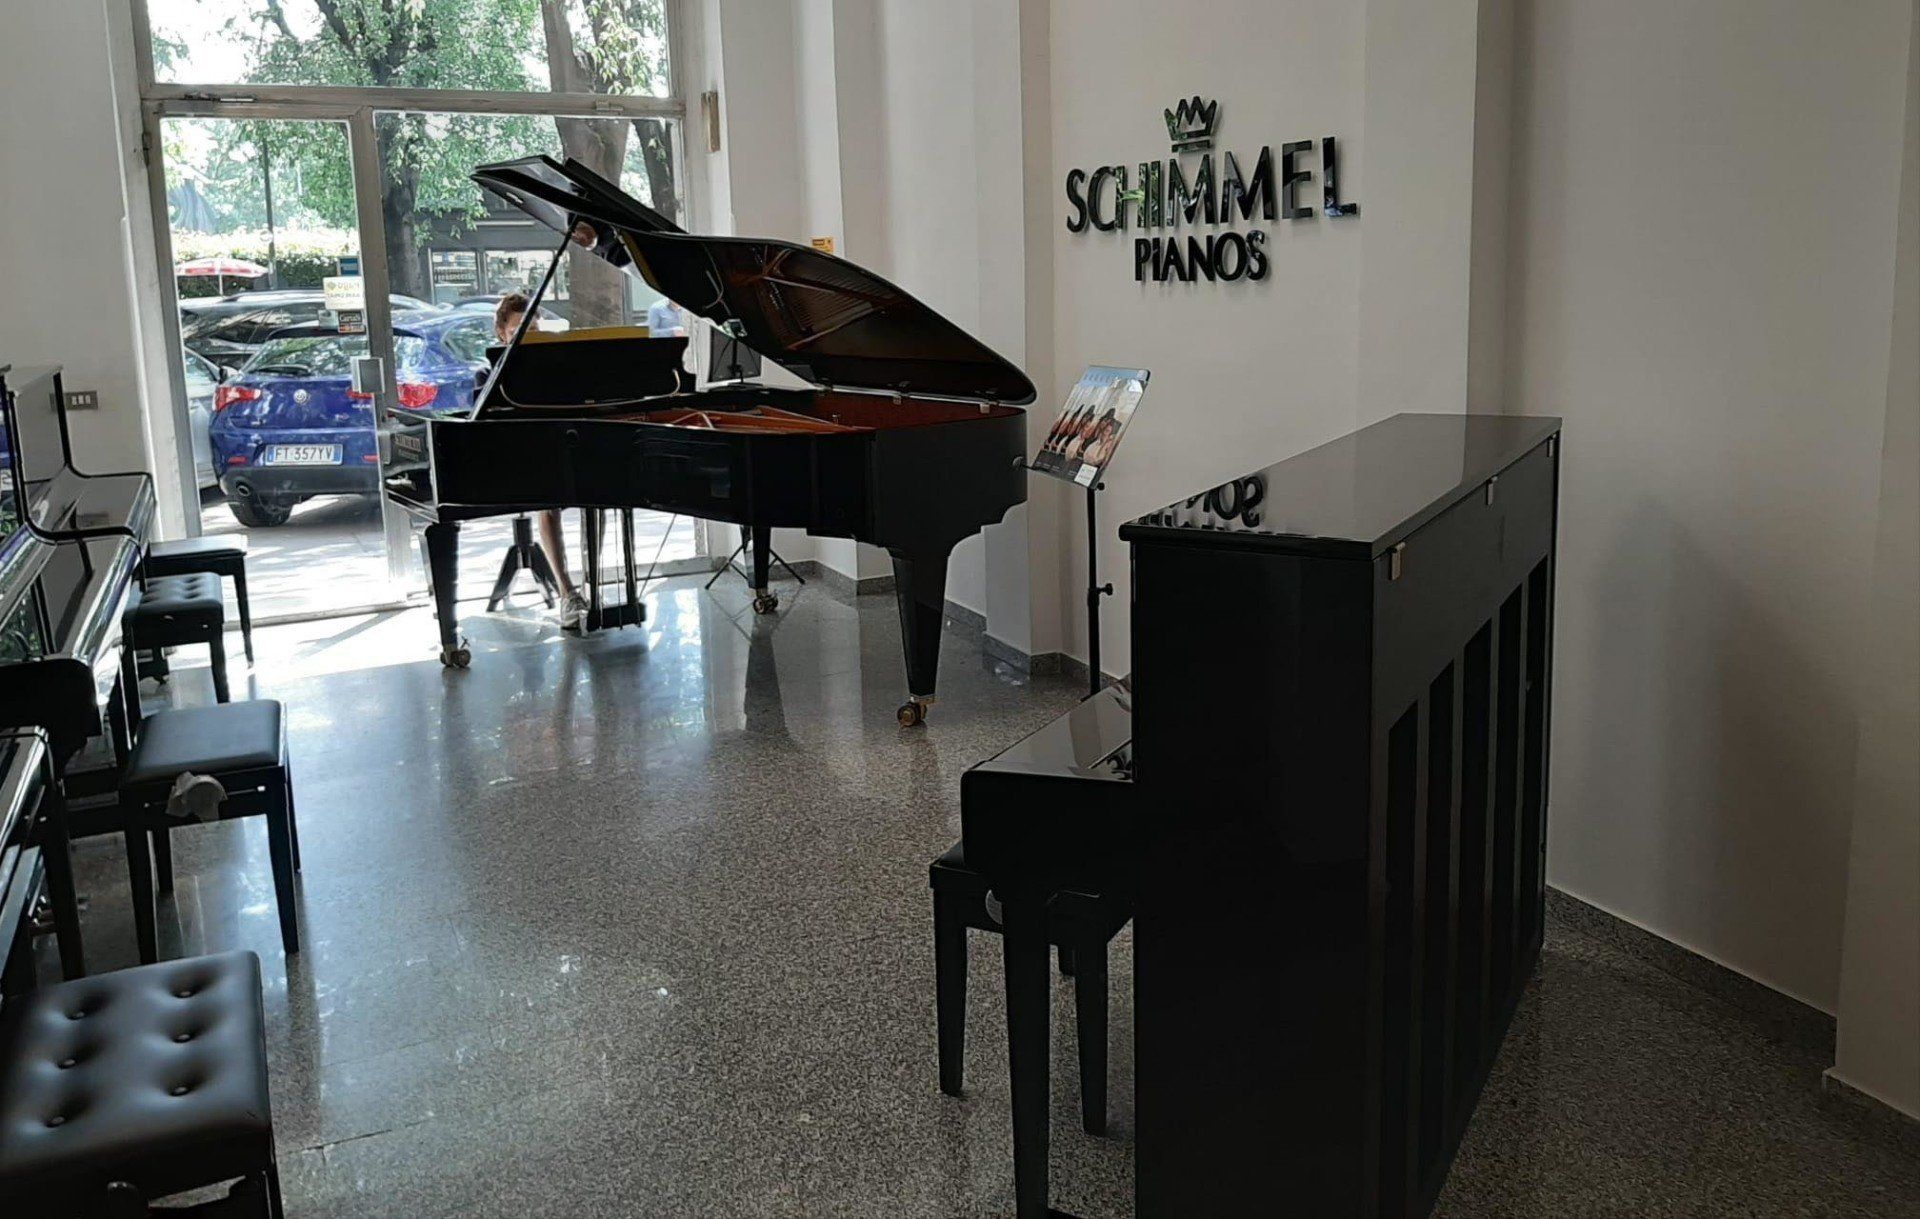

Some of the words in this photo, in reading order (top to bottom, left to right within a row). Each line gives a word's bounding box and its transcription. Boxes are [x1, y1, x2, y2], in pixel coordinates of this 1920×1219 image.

[1066, 136, 1357, 233] SCHIMMEL
[1134, 230, 1268, 282] PIANOS
[275, 447, 289, 459] FT
[294, 446, 333, 459] 357YV
